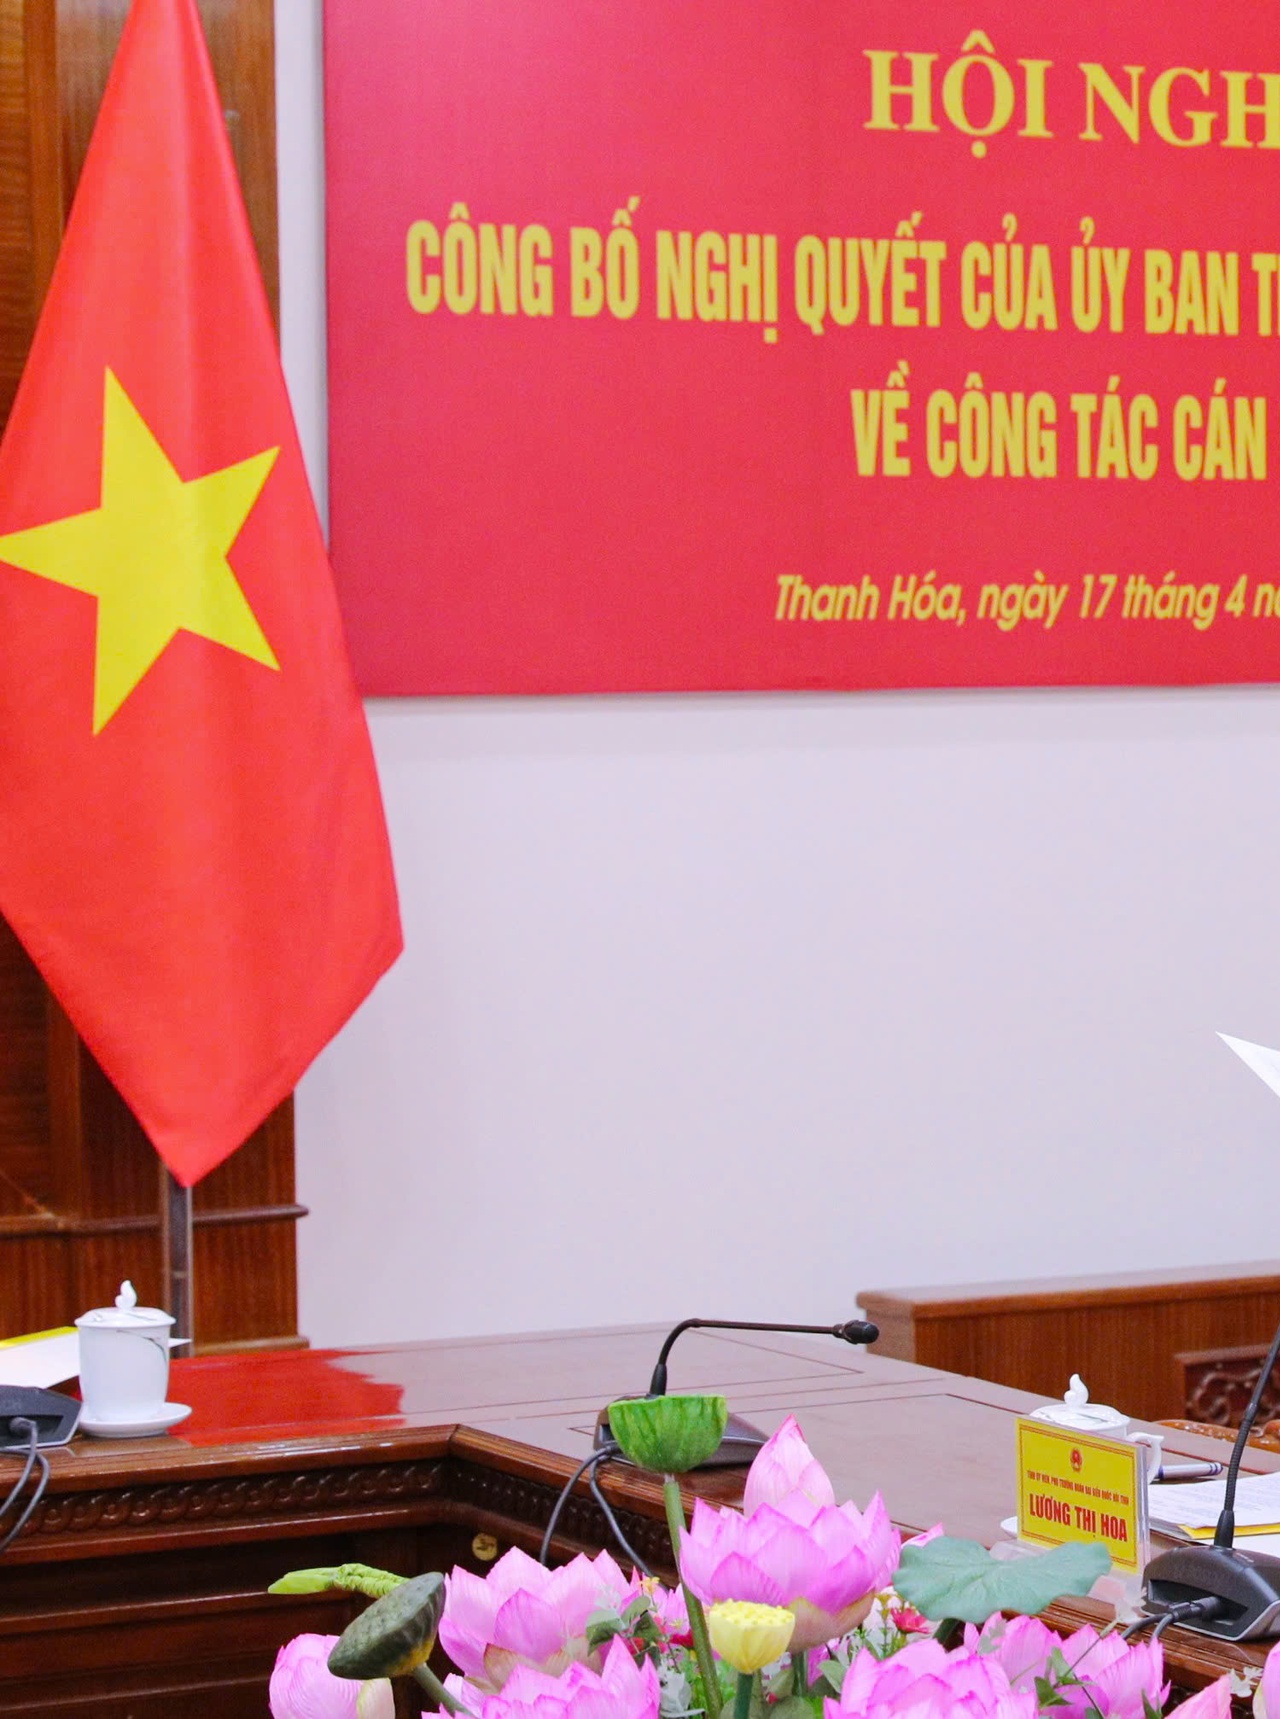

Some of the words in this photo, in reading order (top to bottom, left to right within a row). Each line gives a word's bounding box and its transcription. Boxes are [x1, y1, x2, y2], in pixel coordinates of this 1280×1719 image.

[864, 29, 1053, 159] HỘI
[406, 202, 554, 318] CÔNG
[570, 195, 641, 320] BỐ
[656, 230, 779, 344] NGHỊ
[794, 210, 947, 336] QUYẾT
[960, 213, 1058, 331] CỦA
[1071, 216, 1131, 333] ỦY
[1144, 249, 1239, 336] BAN
[850, 360, 911, 477] VỀ
[926, 371, 1058, 479] CÔNG
[1070, 375, 1159, 481] TÁC
[1173, 377, 1267, 481] CÁN
[776, 574, 881, 622] Thanh
[887, 570, 966, 625] Hóa,
[977, 570, 1069, 632] ngày
[1080, 573, 1118, 619] 17
[1122, 571, 1221, 631] tháng
[1225, 574, 1246, 618] 4
[1029, 1493, 1071, 1527] LƯƠNG
[1074, 1505, 1097, 1538] THỊ
[1100, 1513, 1128, 1542] HOA
